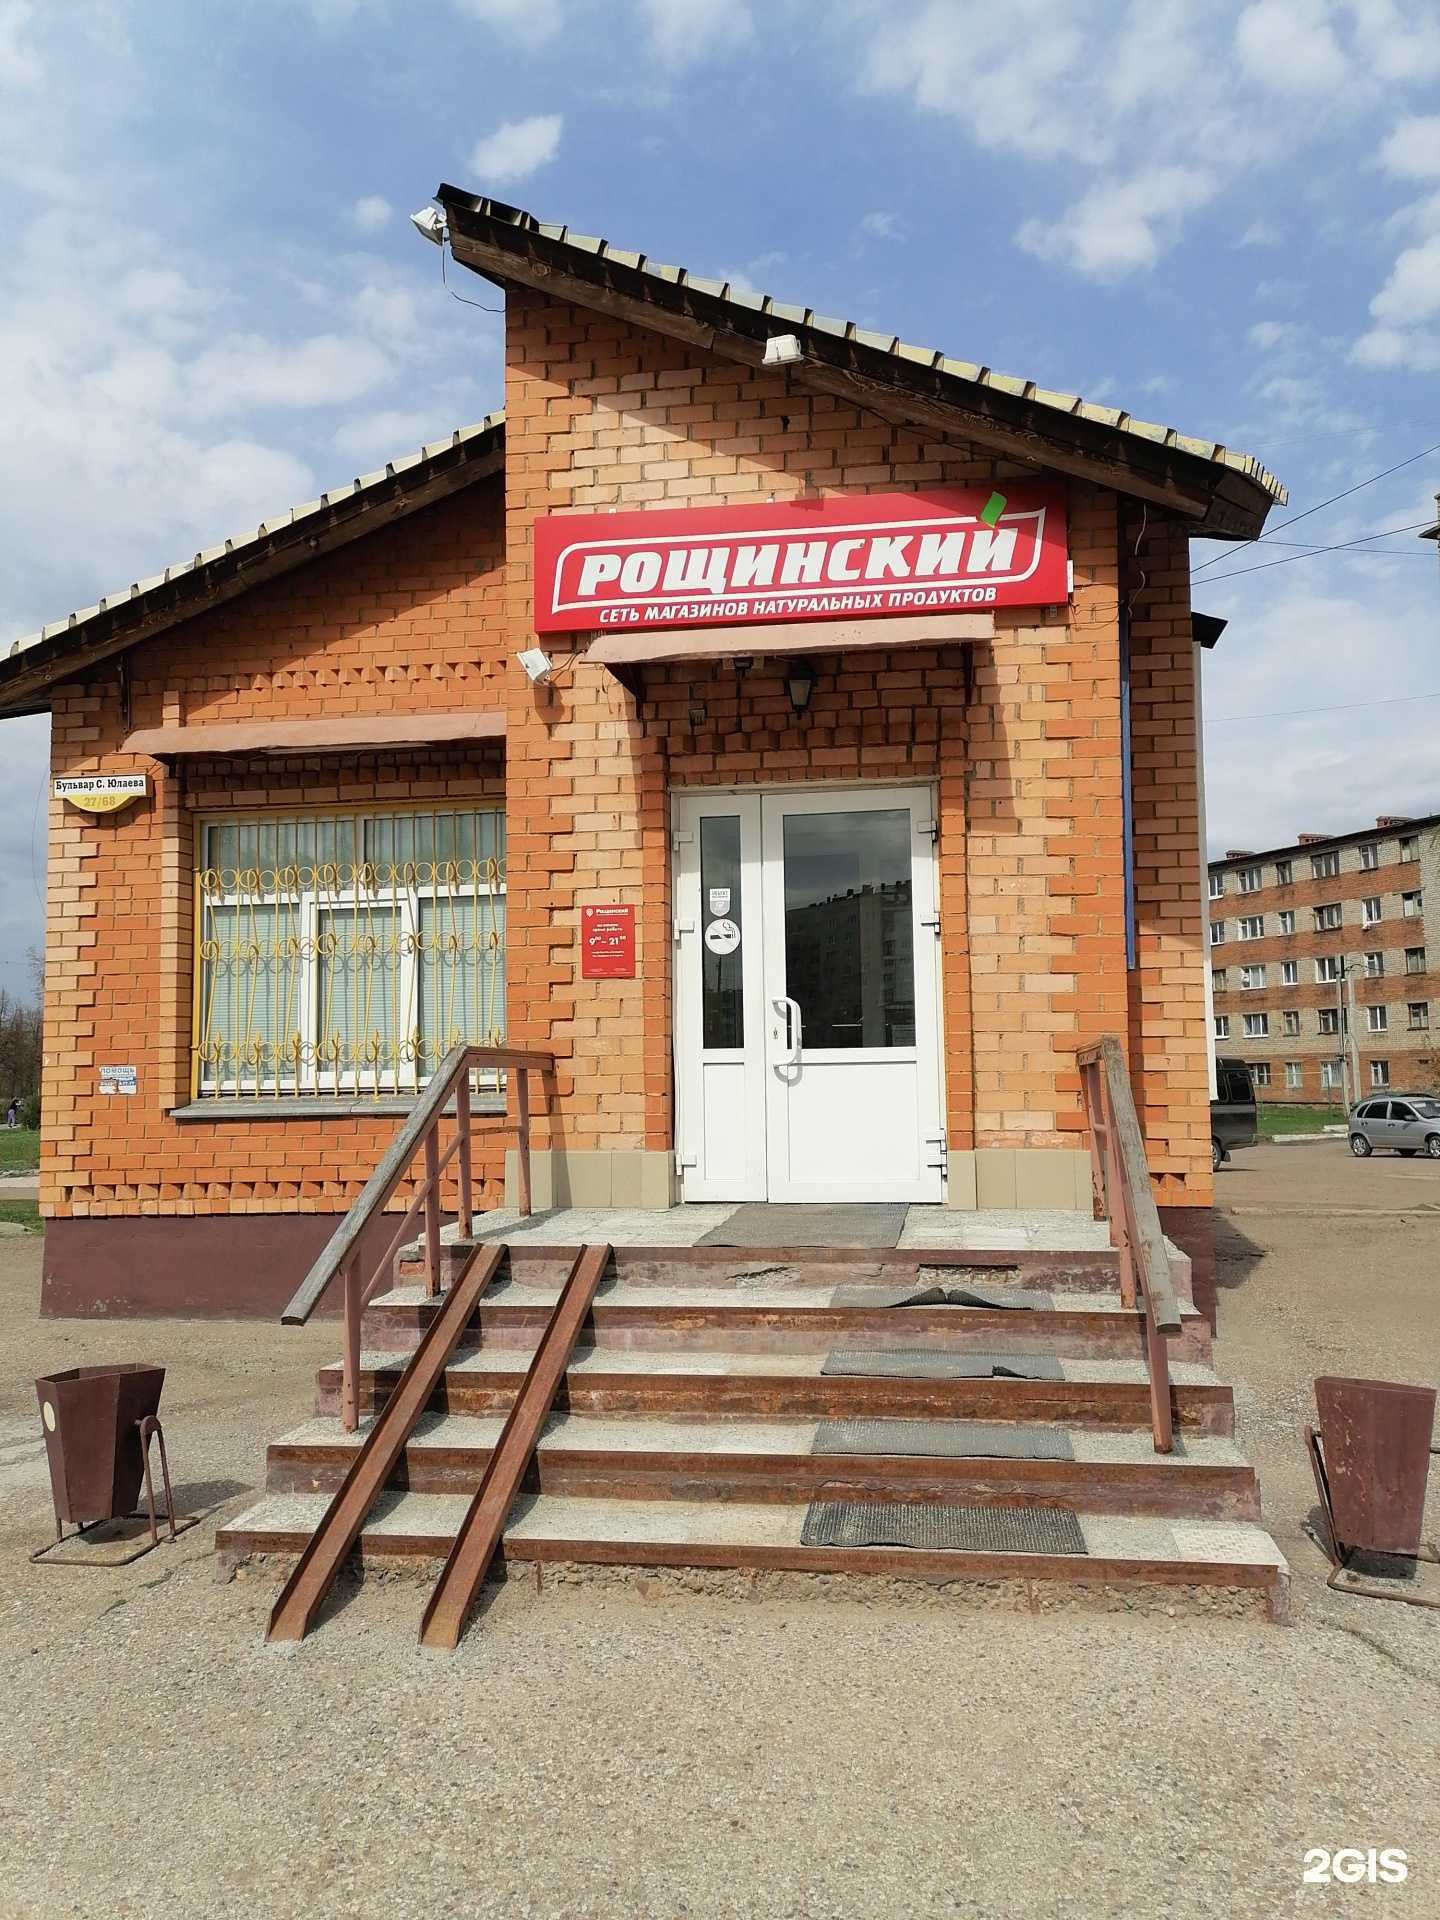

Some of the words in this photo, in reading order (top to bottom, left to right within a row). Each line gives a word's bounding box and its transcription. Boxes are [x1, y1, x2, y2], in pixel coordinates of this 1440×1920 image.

[600, 608, 640, 623] СЕТЬ
[644, 602, 748, 621] МАГАЗИНОВ
[752, 593, 883, 615] НАТУРАЛЬНЫХ
[888, 587, 997, 608] ПРОДУКТОВ
[56, 780, 94, 791] Бульвар
[96, 780, 105, 789] С.
[107, 779, 144, 788] Юлаева
[84, 796, 116, 807] 27/68
